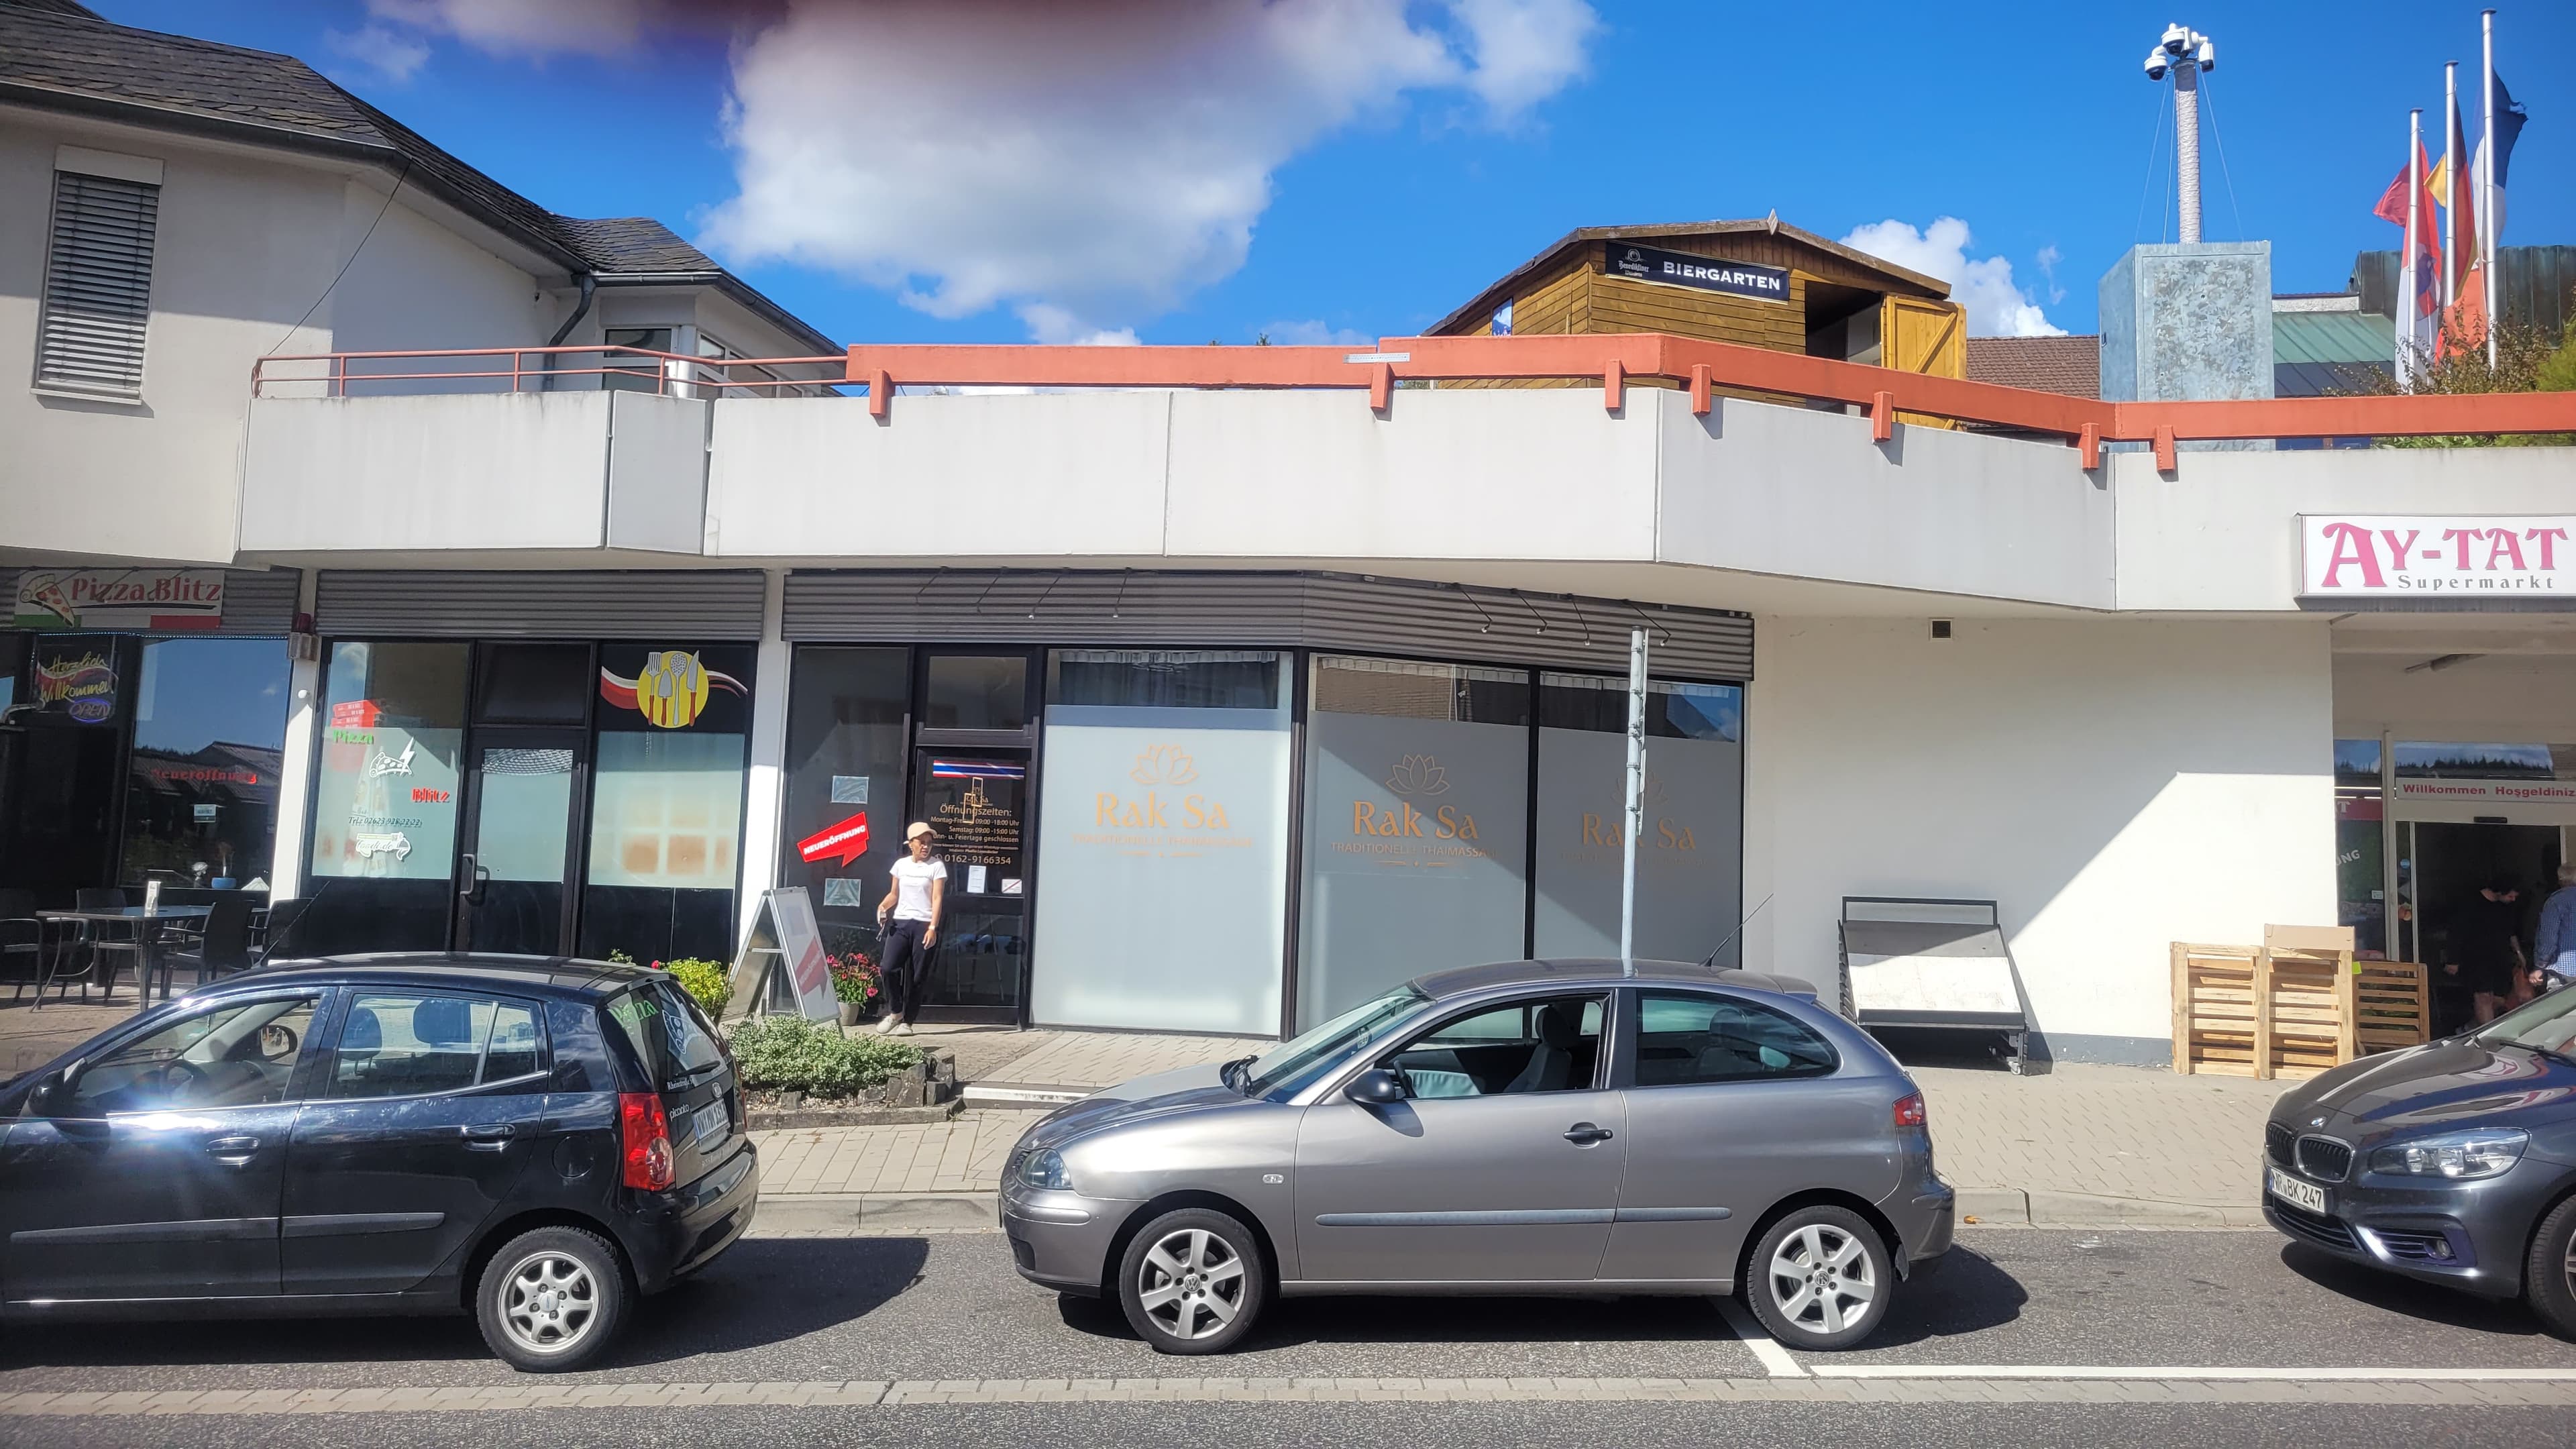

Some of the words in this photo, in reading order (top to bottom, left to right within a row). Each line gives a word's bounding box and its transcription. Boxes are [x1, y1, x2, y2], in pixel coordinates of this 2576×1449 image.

[1663, 261, 1780, 290] BIERGARTEN
[2321, 522, 2569, 588] AY-TAT
[72, 577, 146, 601] Pizza
[155, 577, 221, 601] Blitz
[2398, 575, 2555, 591] Supermarkt
[47, 651, 109, 681] Herzlich
[41, 680, 114, 703] Willkommen
[70, 704, 110, 716] OPEN
[333, 729, 374, 744] Pizza
[412, 788, 449, 803] Blitz
[2403, 784, 2487, 796] Willkommen
[2495, 786, 2576, 798] Hoşgeldiniz
[940, 803, 1012, 816] Öffnungszeiten:
[1095, 790, 1169, 828] Rak
[1182, 794, 1230, 829] Sa
[1353, 800, 1423, 838] Rak
[1435, 805, 1479, 839] Sa
[803, 825, 865, 855] NEUERÖFFNUNG
[949, 826, 973, 834] Samstag:
[955, 834, 983, 842] Feiertage
[1582, 812, 1644, 848] Ra
[1657, 817, 1697, 850] Sa
[945, 854, 1011, 865] 0162-9166354
[2272, 1171, 2284, 1193] NR
[2287, 1178, 2300, 1201] BK
[2302, 1184, 2322, 1209] 247
